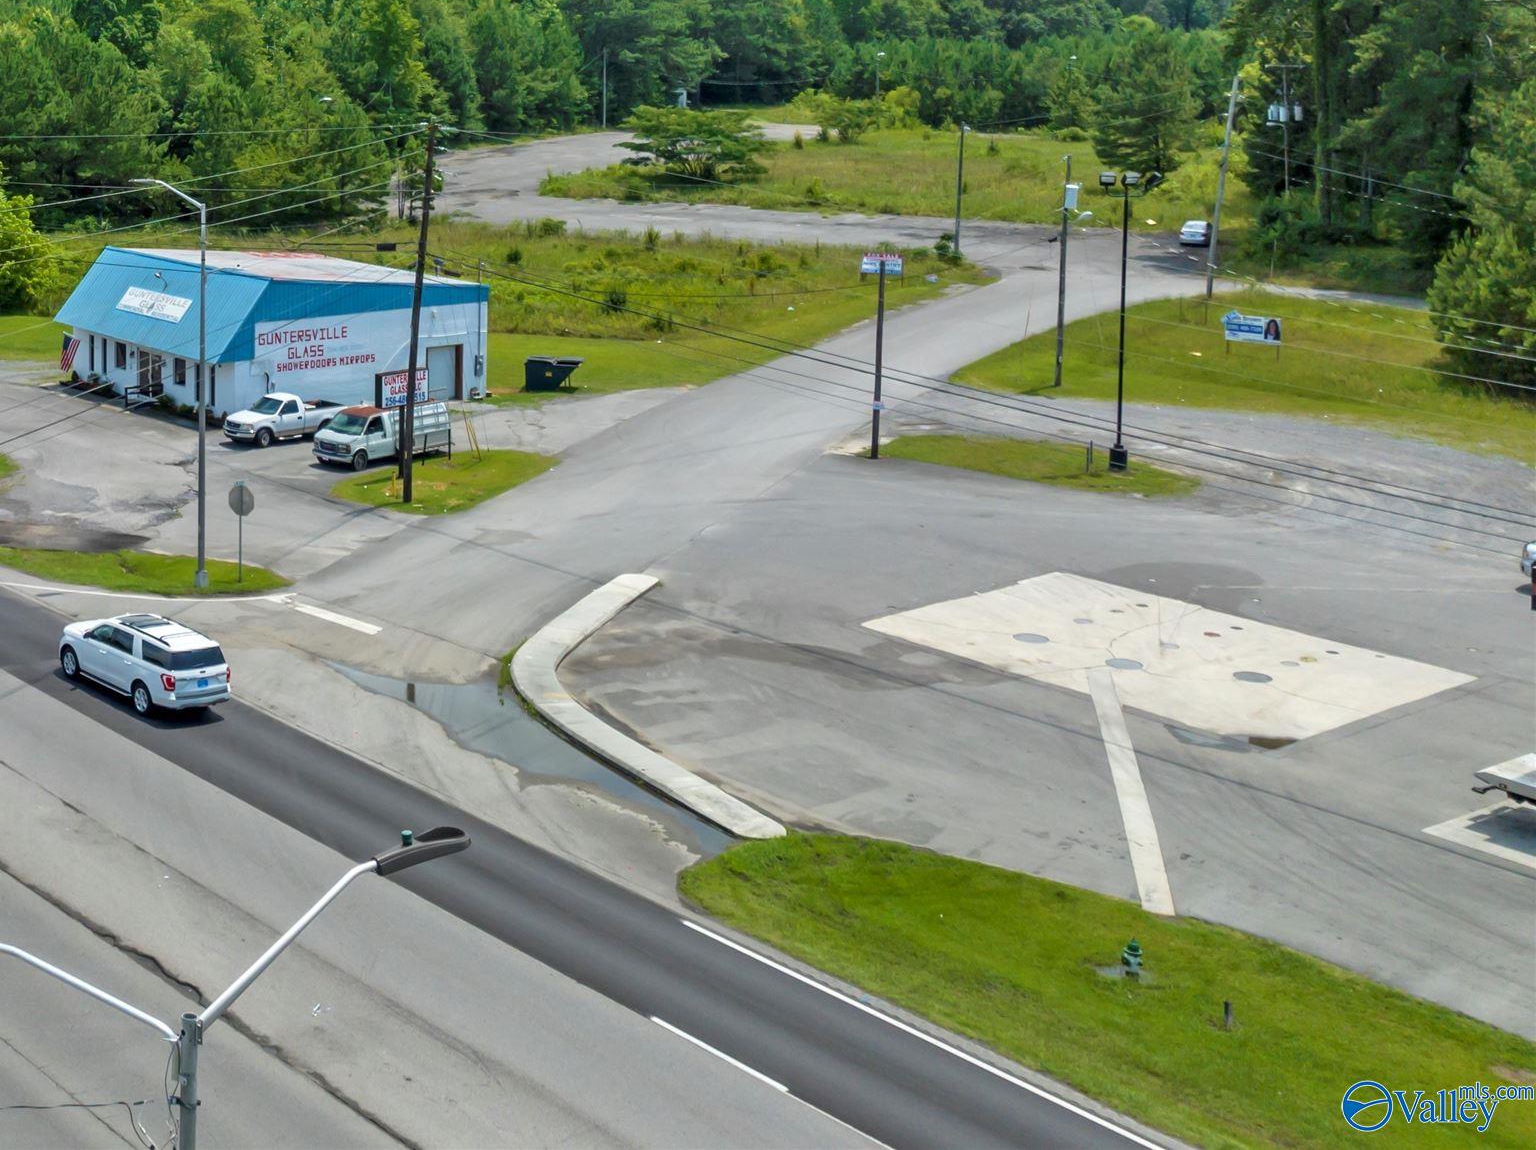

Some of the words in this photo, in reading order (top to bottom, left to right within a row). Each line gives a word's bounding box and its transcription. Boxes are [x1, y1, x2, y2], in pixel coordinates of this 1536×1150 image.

[128, 289, 189, 307] GUNTERSVILLE
[258, 326, 348, 346] GUNTERSVILLE
[287, 345, 324, 360] GLASS
[276, 358, 337, 372] SHOWERDOORS
[339, 354, 375, 366] MIRRORS
[384, 370, 427, 386] GUNTERLLE
